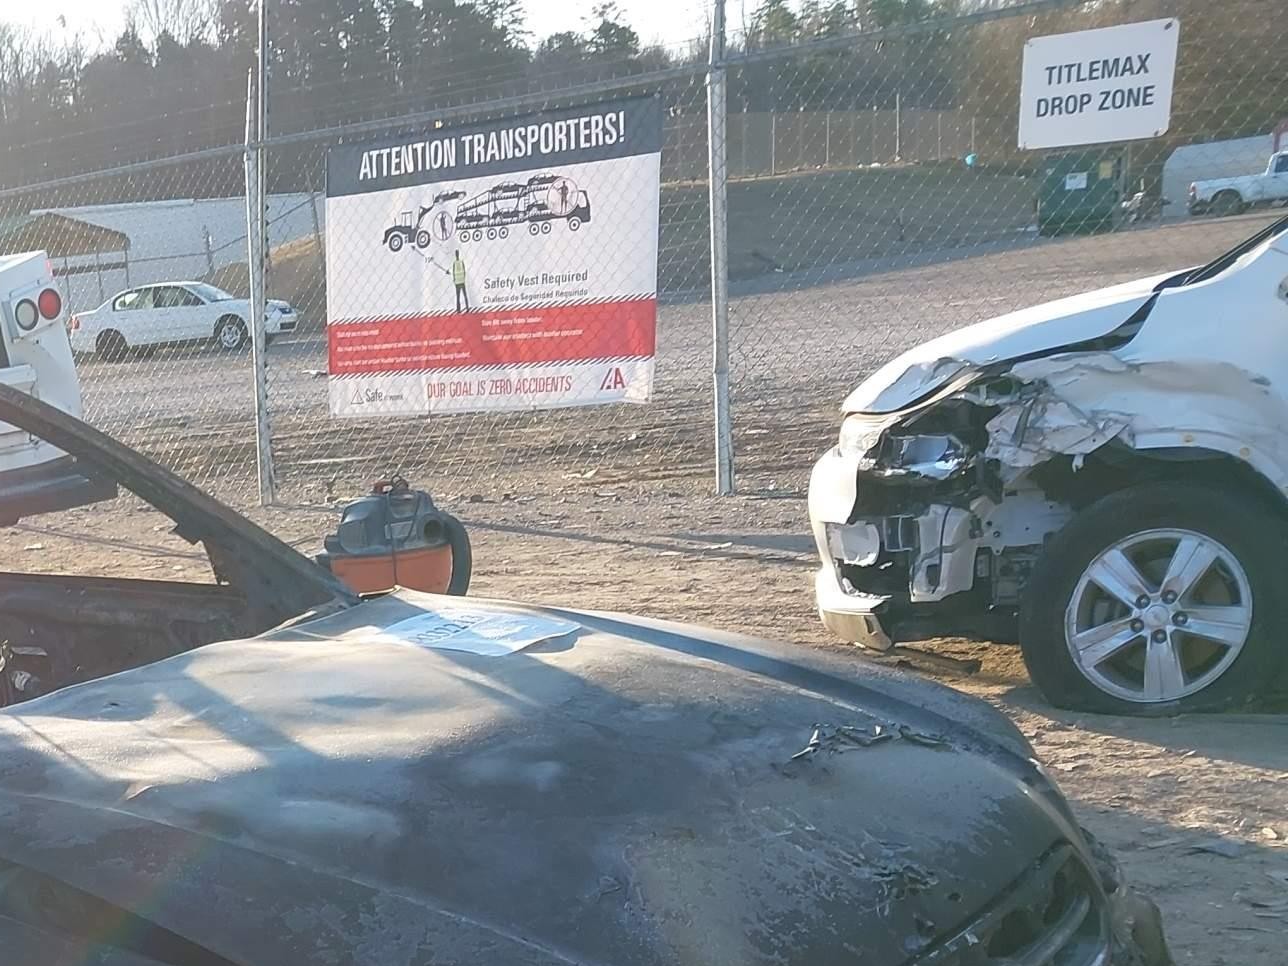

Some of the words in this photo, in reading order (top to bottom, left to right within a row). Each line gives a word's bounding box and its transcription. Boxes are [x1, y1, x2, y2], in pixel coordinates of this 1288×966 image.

[1045, 53, 1151, 85] TITLEMAX
[1036, 93, 1092, 118] DROP
[1098, 85, 1155, 111] ZONE
[359, 138, 456, 180] ATTENTION
[462, 111, 626, 165] TRANSPORTERS!
[484, 276, 515, 290] Safety
[518, 273, 539, 286] Vest
[542, 270, 588, 286] Required
[365, 388, 383, 402] Safe
[427, 383, 446, 398] OUR
[449, 381, 473, 396] GOAL
[476, 381, 485, 395] IS
[488, 379, 512, 395] ZERO
[515, 375, 572, 394] ACCIDENTS
